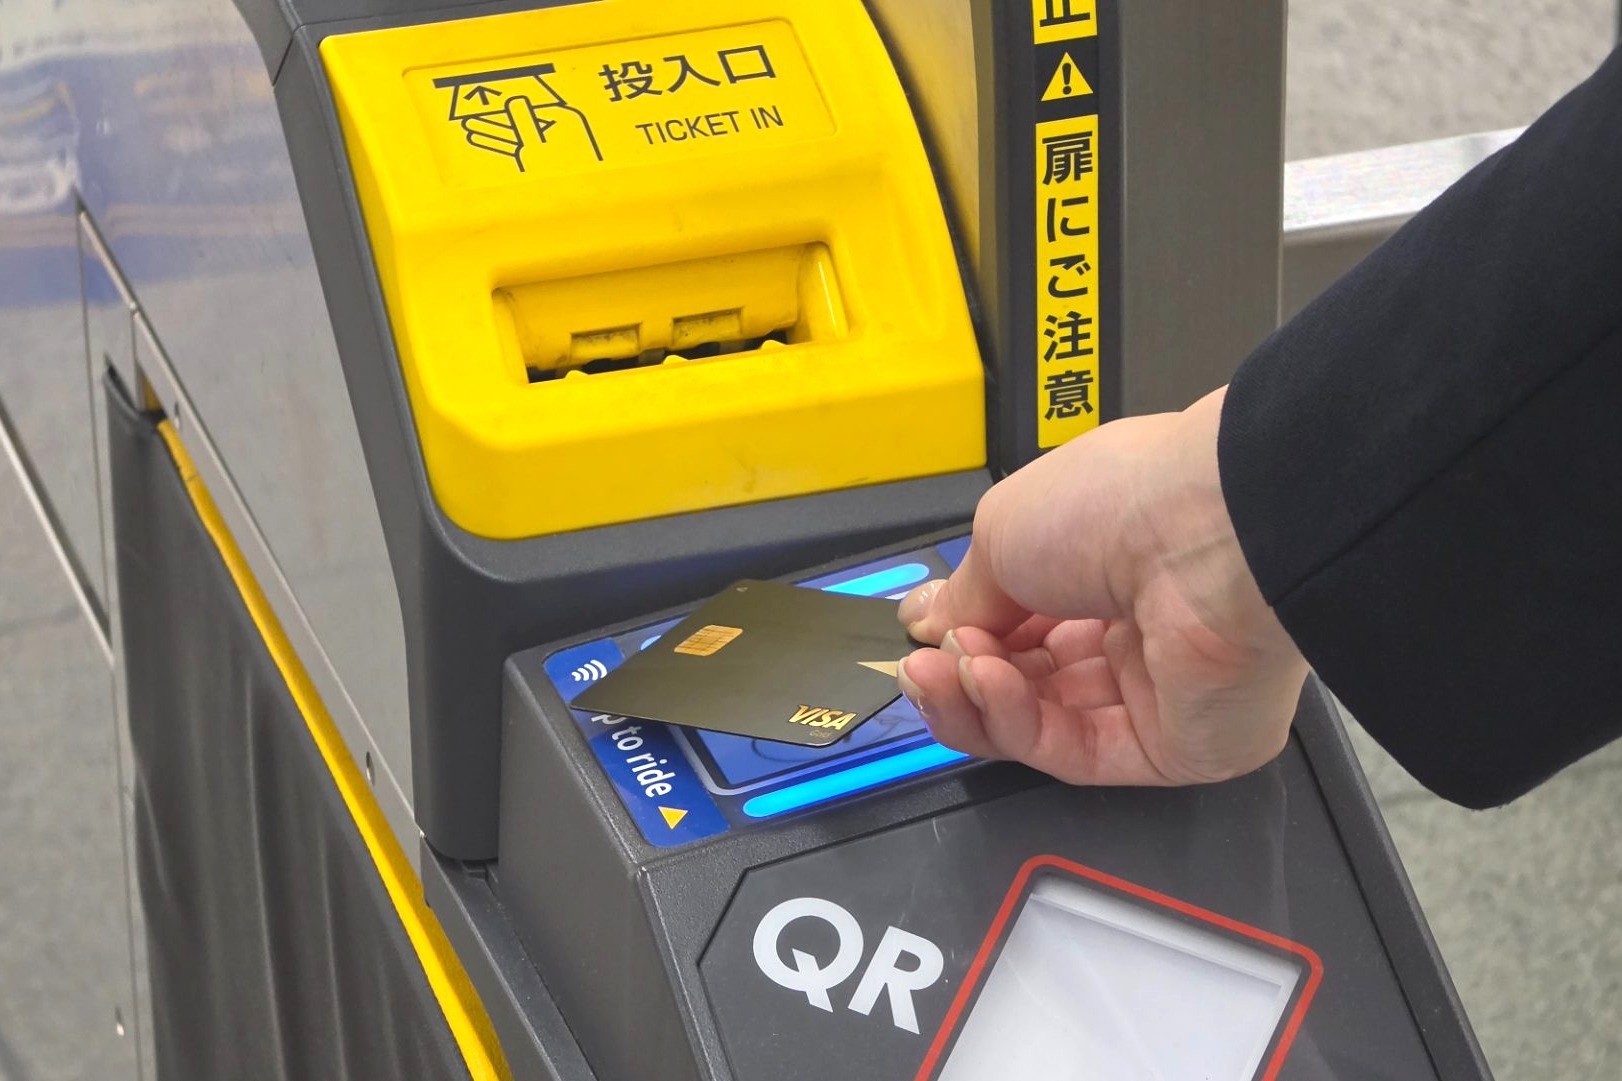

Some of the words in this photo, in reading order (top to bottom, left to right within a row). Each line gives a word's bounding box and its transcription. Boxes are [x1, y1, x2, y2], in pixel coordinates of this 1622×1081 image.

[599, 45, 776, 102] 投入口
[636, 110, 740, 145] TICKET
[749, 105, 784, 130] IN
[1041, 130, 1094, 421] 扉にご注意
[612, 726, 644, 751] to
[789, 704, 856, 731] VISA
[626, 753, 676, 797] ride
[753, 897, 944, 1034] QR
